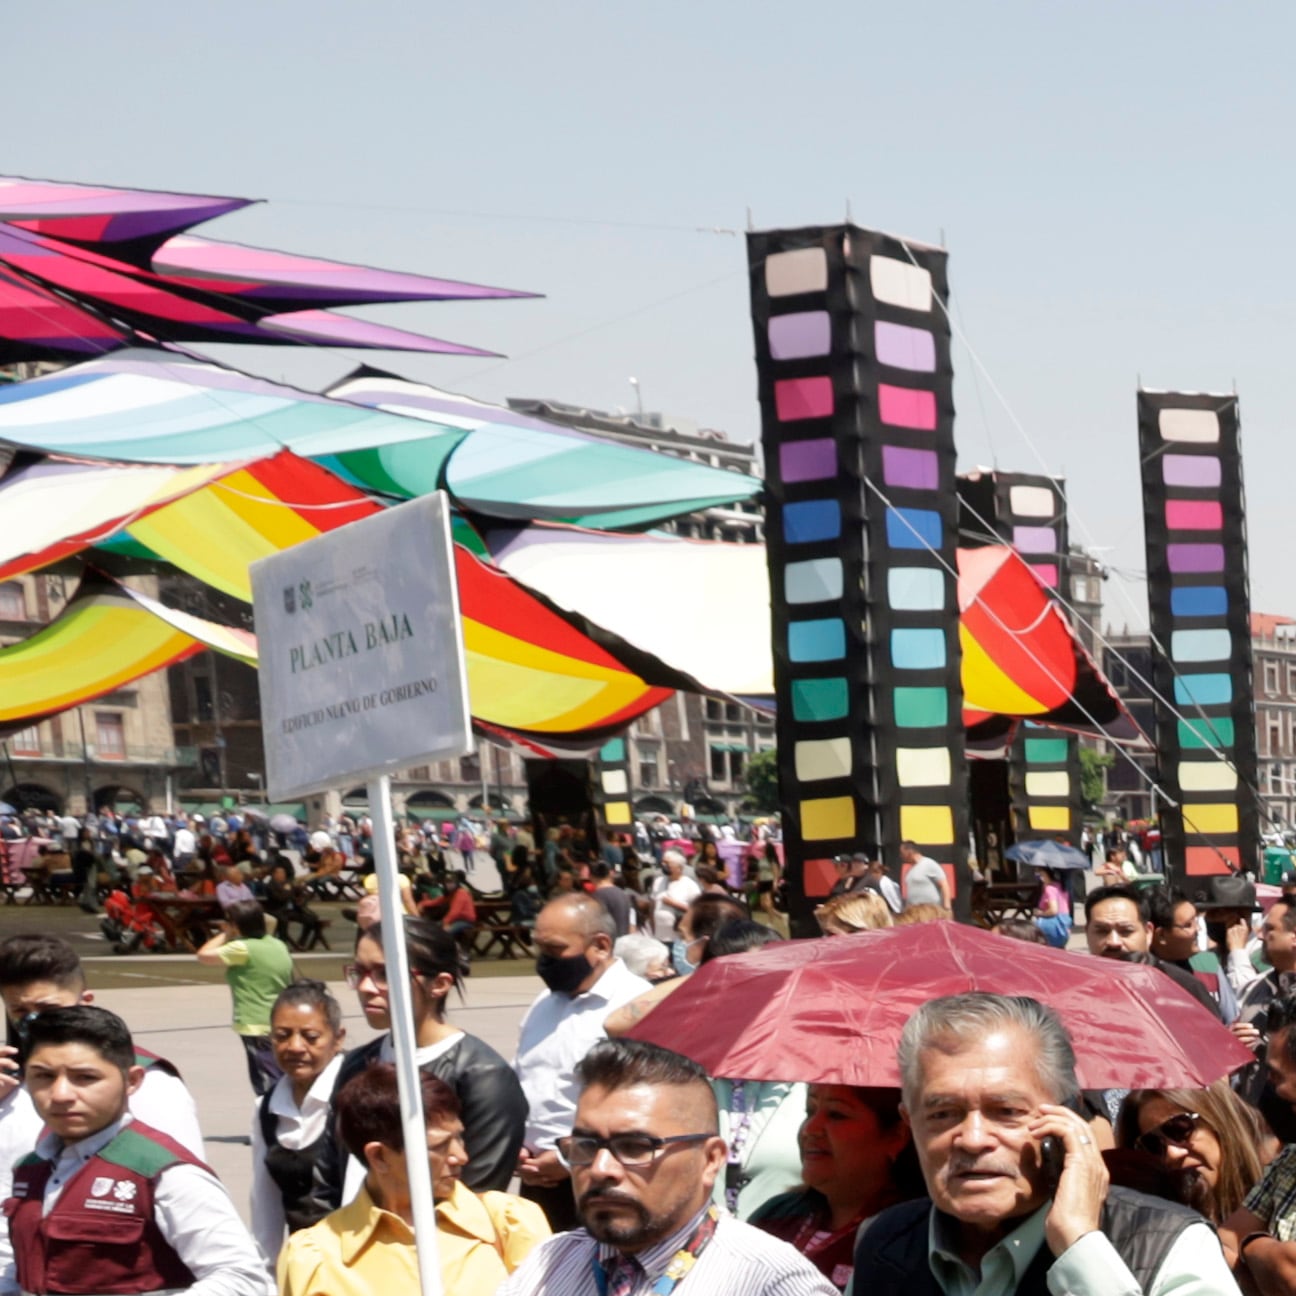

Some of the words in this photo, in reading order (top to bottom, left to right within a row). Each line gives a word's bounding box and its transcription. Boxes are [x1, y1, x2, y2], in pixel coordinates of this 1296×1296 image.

[290, 631, 358, 674] PLANTA
[366, 612, 414, 650] BAJA
[282, 709, 325, 734] EDIFICIO
[326, 698, 361, 719] NUEVO
[363, 693, 377, 711] DE
[380, 678, 438, 706] GOBIERNO
